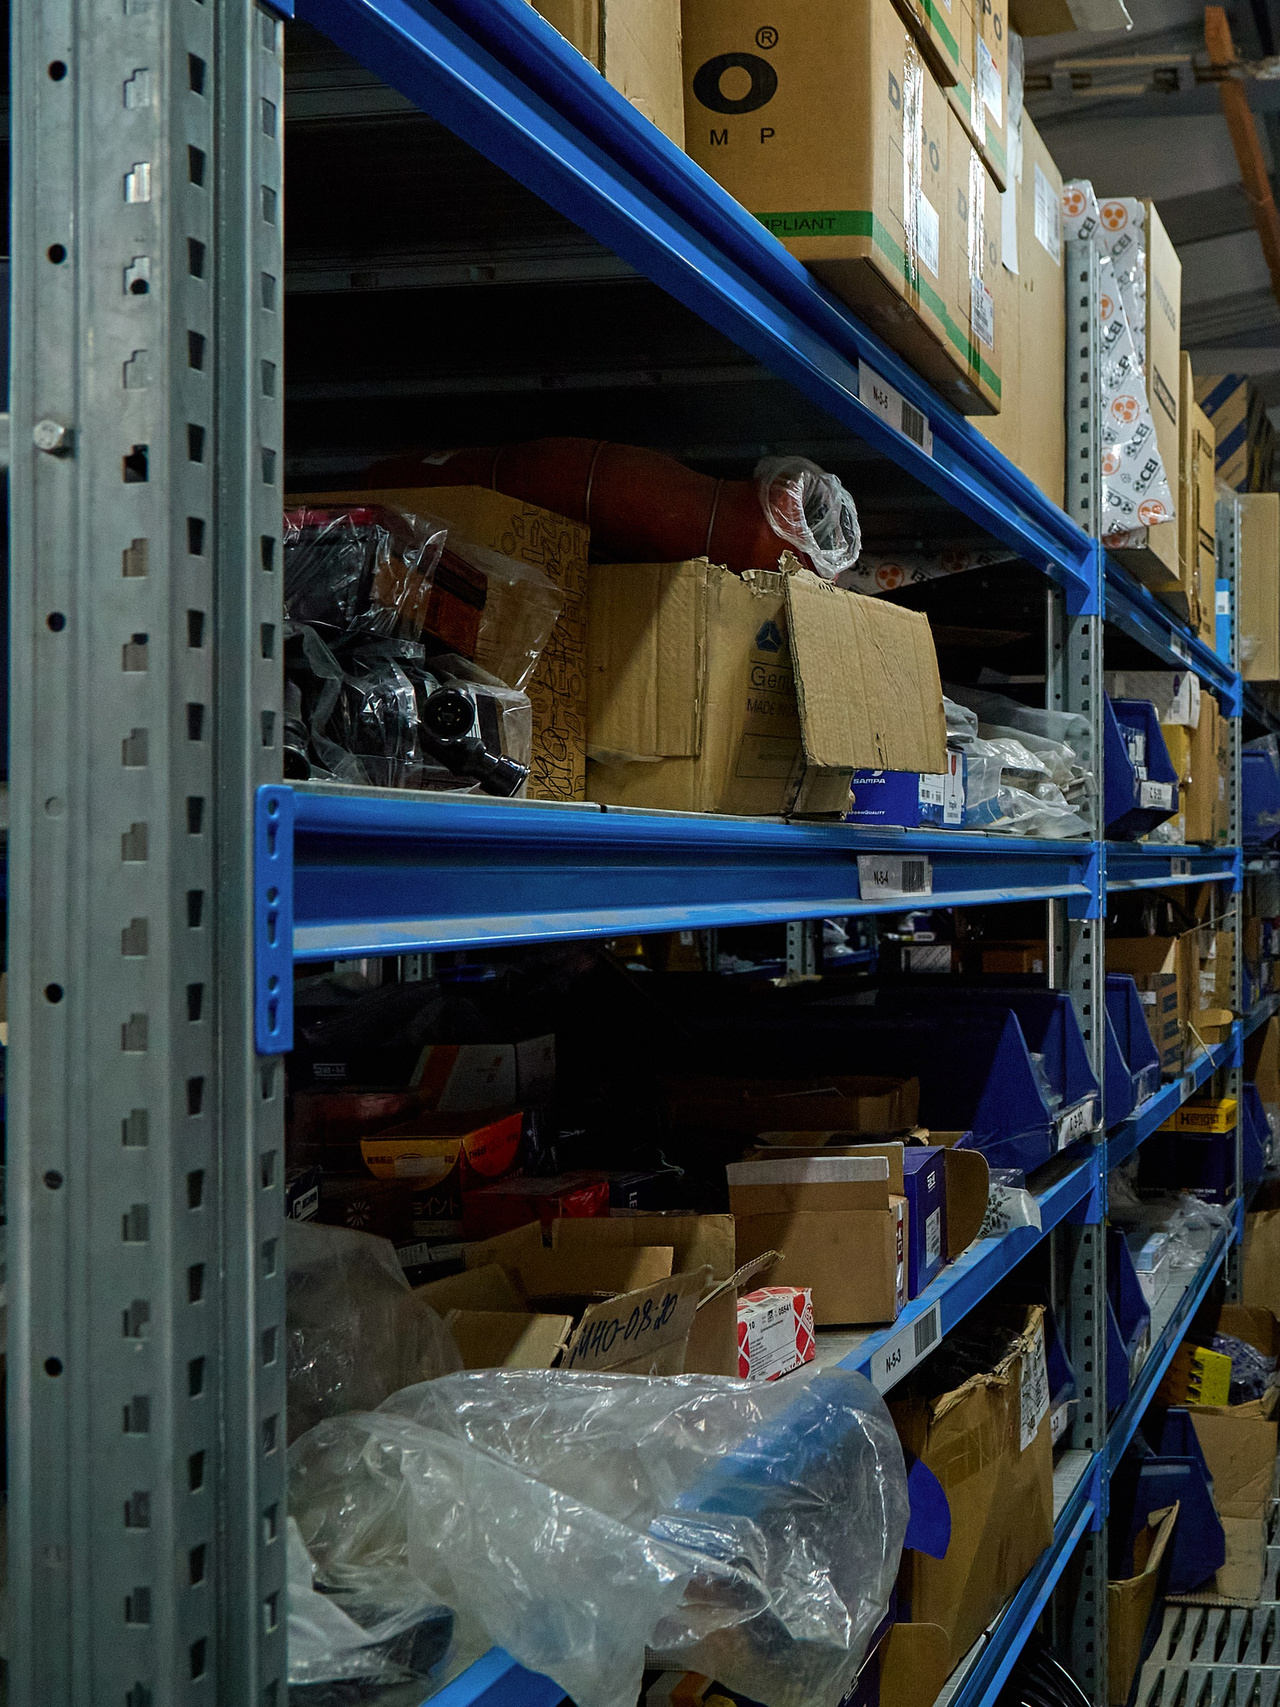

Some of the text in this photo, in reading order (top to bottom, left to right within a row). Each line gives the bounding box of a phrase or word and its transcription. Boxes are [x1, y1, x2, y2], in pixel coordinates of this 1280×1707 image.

[1077, 216, 1097, 241] CEI
[1111, 233, 1133, 256] CEI
[1105, 320, 1123, 343] CEI
[1131, 423, 1150, 446] CEI
[1140, 458, 1159, 482] CEI
[885, 1347, 902, 1374] N-5-3
